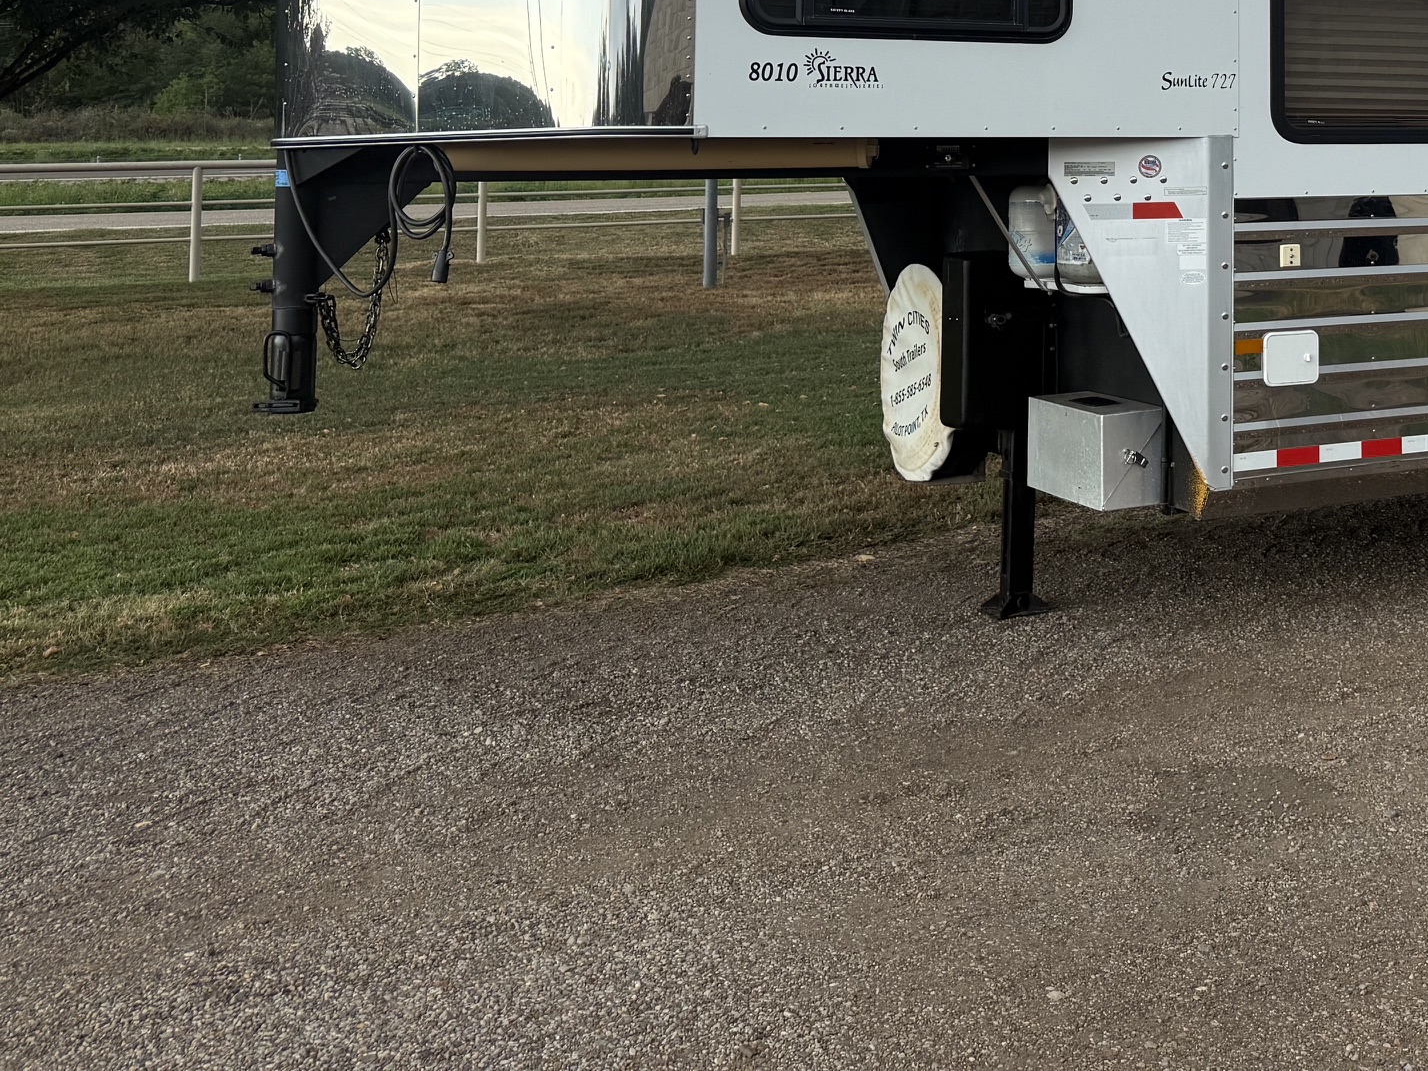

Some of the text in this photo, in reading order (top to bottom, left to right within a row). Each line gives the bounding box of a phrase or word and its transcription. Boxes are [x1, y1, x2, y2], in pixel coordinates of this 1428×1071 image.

[749, 60, 879, 88] 8010 SIERRA
[1211, 73, 1236, 89] 727
[887, 310, 930, 356] TWIN CITIES
[892, 343, 926, 372] South Trailers
[921, 404, 929, 422] TX
